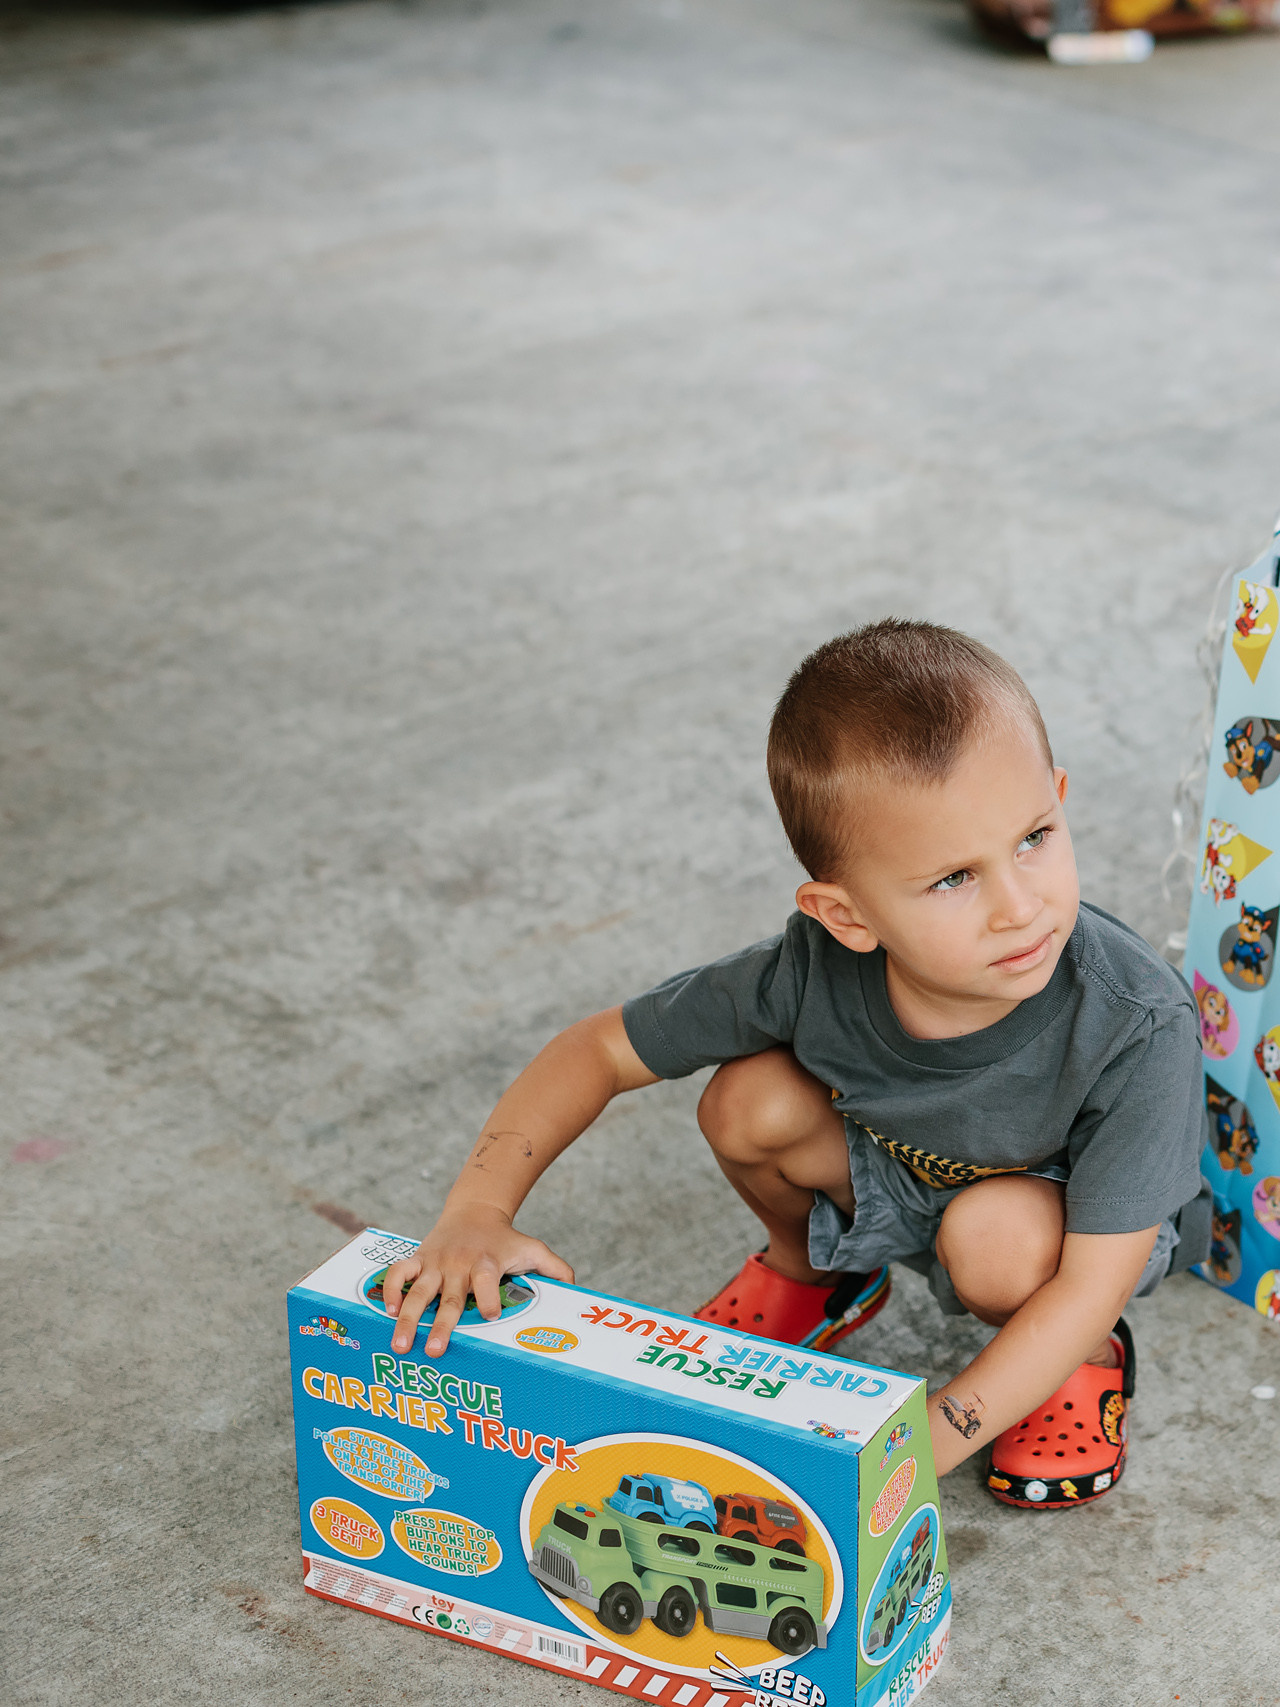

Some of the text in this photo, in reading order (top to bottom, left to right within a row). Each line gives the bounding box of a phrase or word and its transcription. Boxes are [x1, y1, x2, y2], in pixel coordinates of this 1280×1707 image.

[882, 1141, 976, 1177] NING
[300, 1325, 360, 1350] EXPLORERS
[517, 1334, 560, 1348] TRUCK
[580, 1305, 891, 1398] CARRIER TRUCK
[372, 1352, 503, 1418] RESCUE
[637, 1345, 788, 1400] RESCUE
[302, 1366, 580, 1473] CARRIER TRUCK
[313, 1428, 449, 1489] POLICE & FIRE TRUCKS
[349, 1431, 414, 1464] STACK THE
[332, 1448, 425, 1491] ON TOP OF THE
[336, 1460, 425, 1503] TRANSPORTER!
[315, 1504, 380, 1542] 3 TRUCK
[330, 1525, 363, 1550] SET!
[394, 1510, 495, 1542] PRESS THE TOP
[406, 1525, 487, 1553] BUTTONS TO
[408, 1538, 489, 1566] HEAR TRUCK
[547, 1535, 572, 1555] TRUCK
[422, 1554, 480, 1578] SOUNDS!
[431, 1594, 455, 1613] toy
[889, 1634, 931, 1701] RESCUE
[759, 1668, 827, 1707] BEEP
